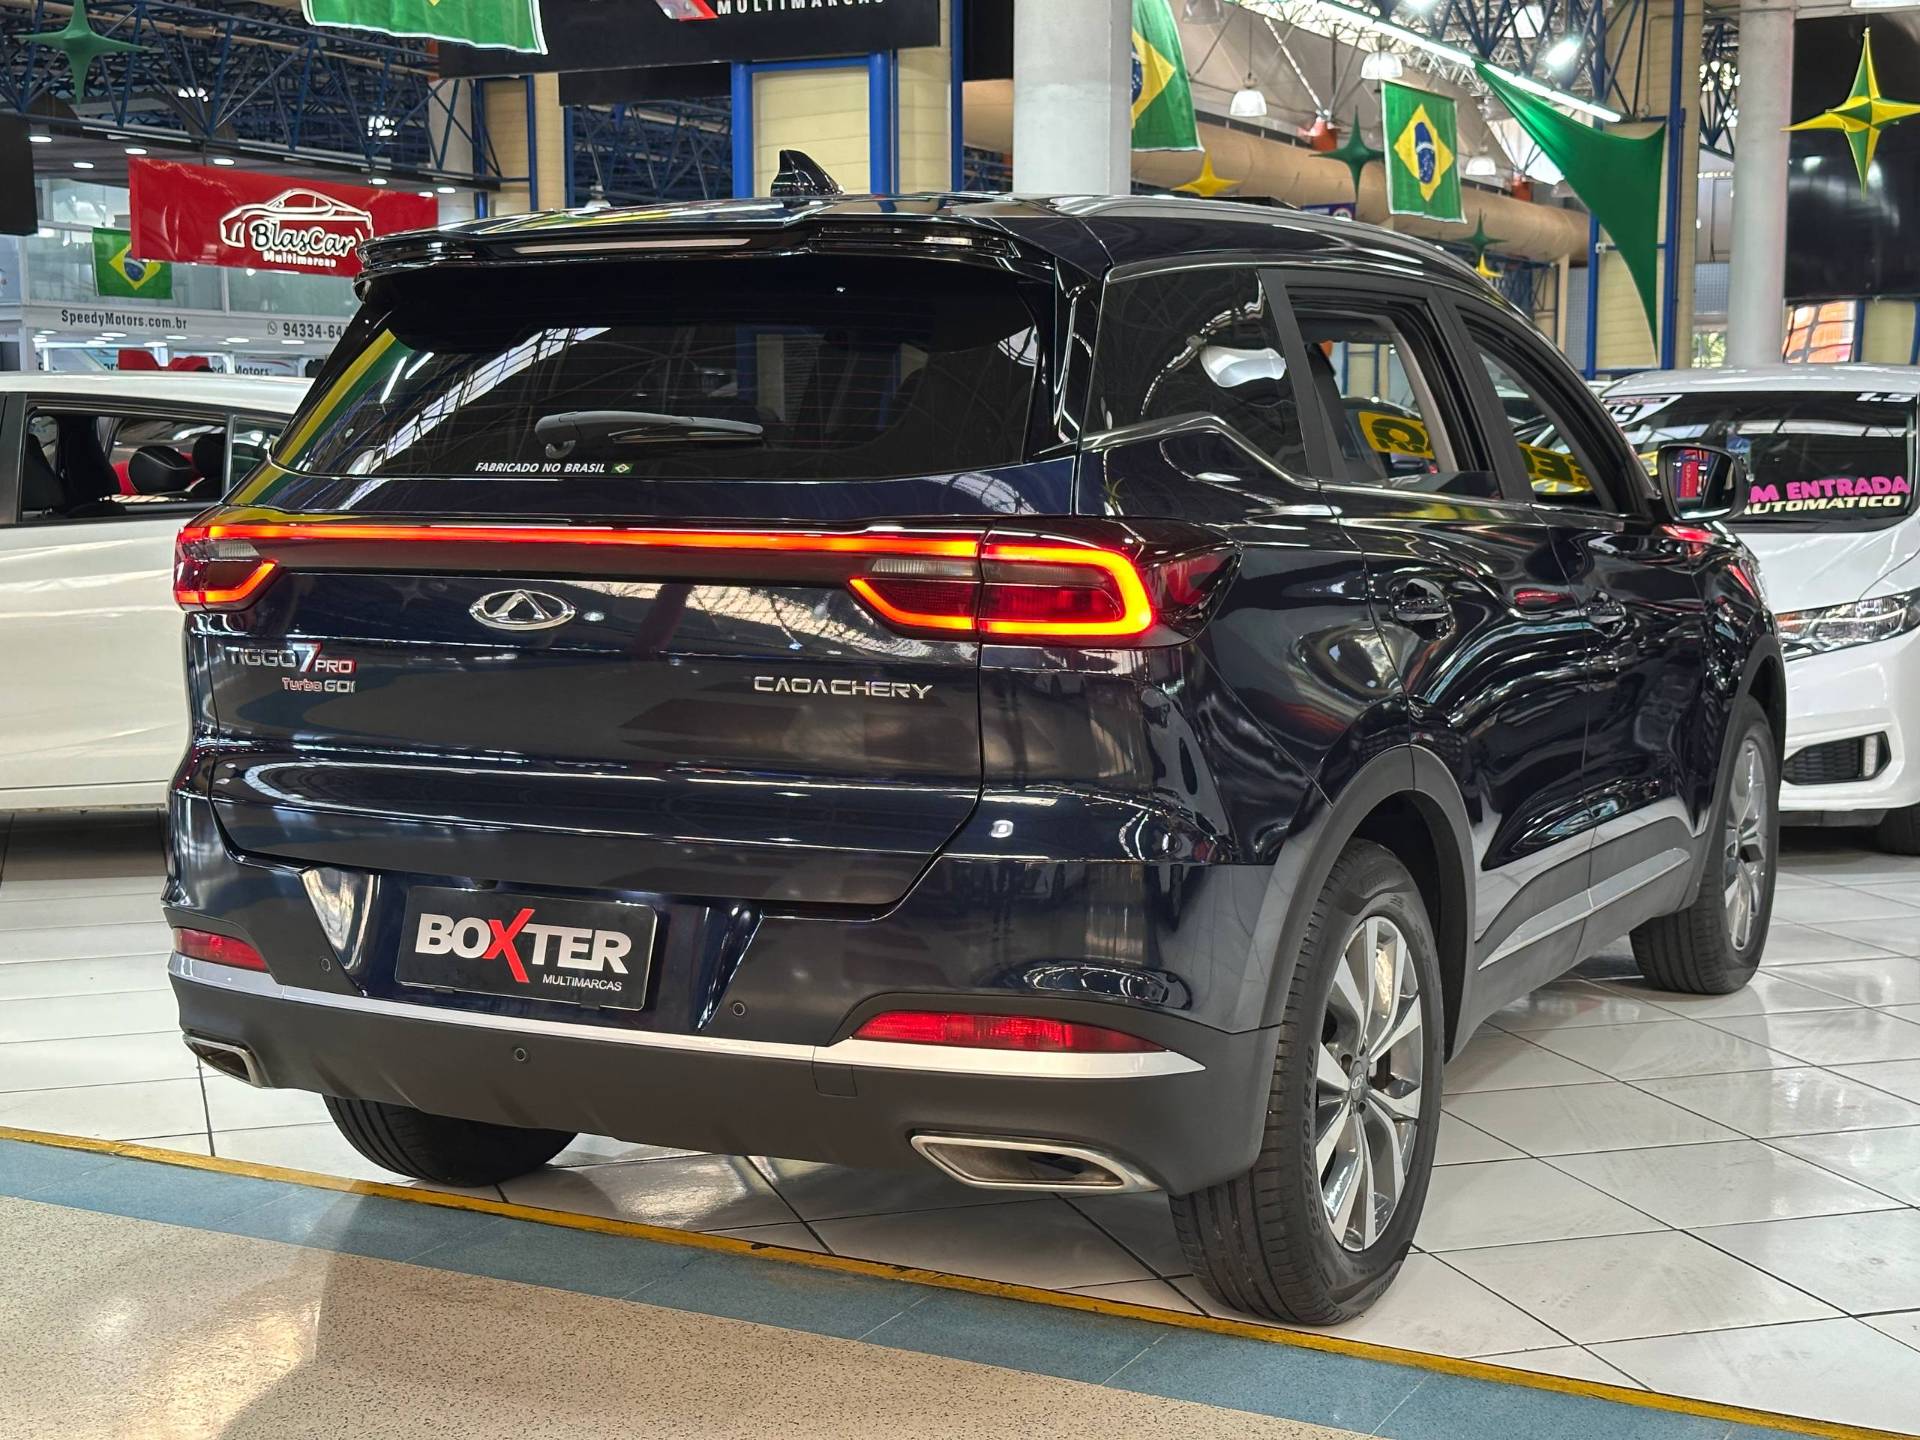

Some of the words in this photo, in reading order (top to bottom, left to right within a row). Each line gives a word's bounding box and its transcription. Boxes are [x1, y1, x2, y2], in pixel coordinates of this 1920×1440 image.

[716, 0, 884, 15] MULTIM
[252, 220, 355, 257] BlasCar
[263, 251, 337, 268] Multimarcas
[61, 309, 187, 329] SpeedyMotors.com.br
[283, 322, 346, 338] 94334-64
[475, 462, 539, 473] FABRICADO
[541, 463, 561, 473] NO
[564, 463, 605, 473] BRASIL
[1786, 475, 1911, 500] ENTRADA
[281, 676, 322, 692] Turbo
[415, 908, 632, 983] BOXTER
[542, 973, 623, 992] MULTIMARCAS
